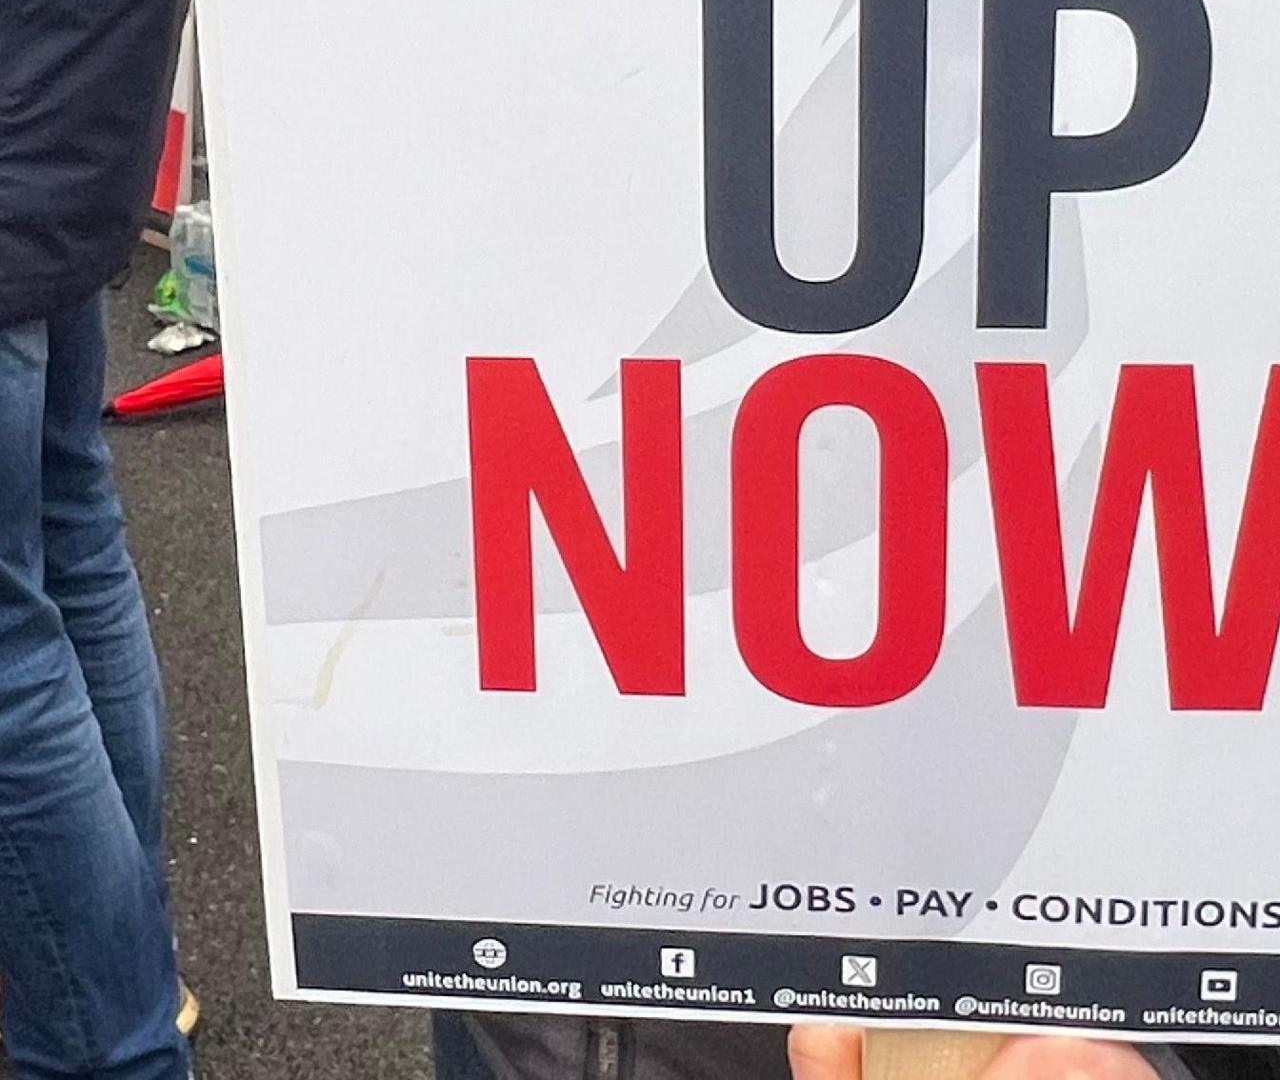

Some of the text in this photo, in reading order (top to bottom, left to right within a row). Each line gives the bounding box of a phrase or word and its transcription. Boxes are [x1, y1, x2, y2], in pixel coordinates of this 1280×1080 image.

[589, 884, 693, 912] Fighting
[699, 887, 741, 913] for
[749, 883, 857, 913] JOBS
[896, 888, 973, 918] PAY
[403, 971, 582, 999] unitetheunion.org
[601, 981, 756, 1005] unitetheunion1
[773, 988, 941, 1011] @unitetheunion
[954, 995, 1126, 1023] @unitetheunion
